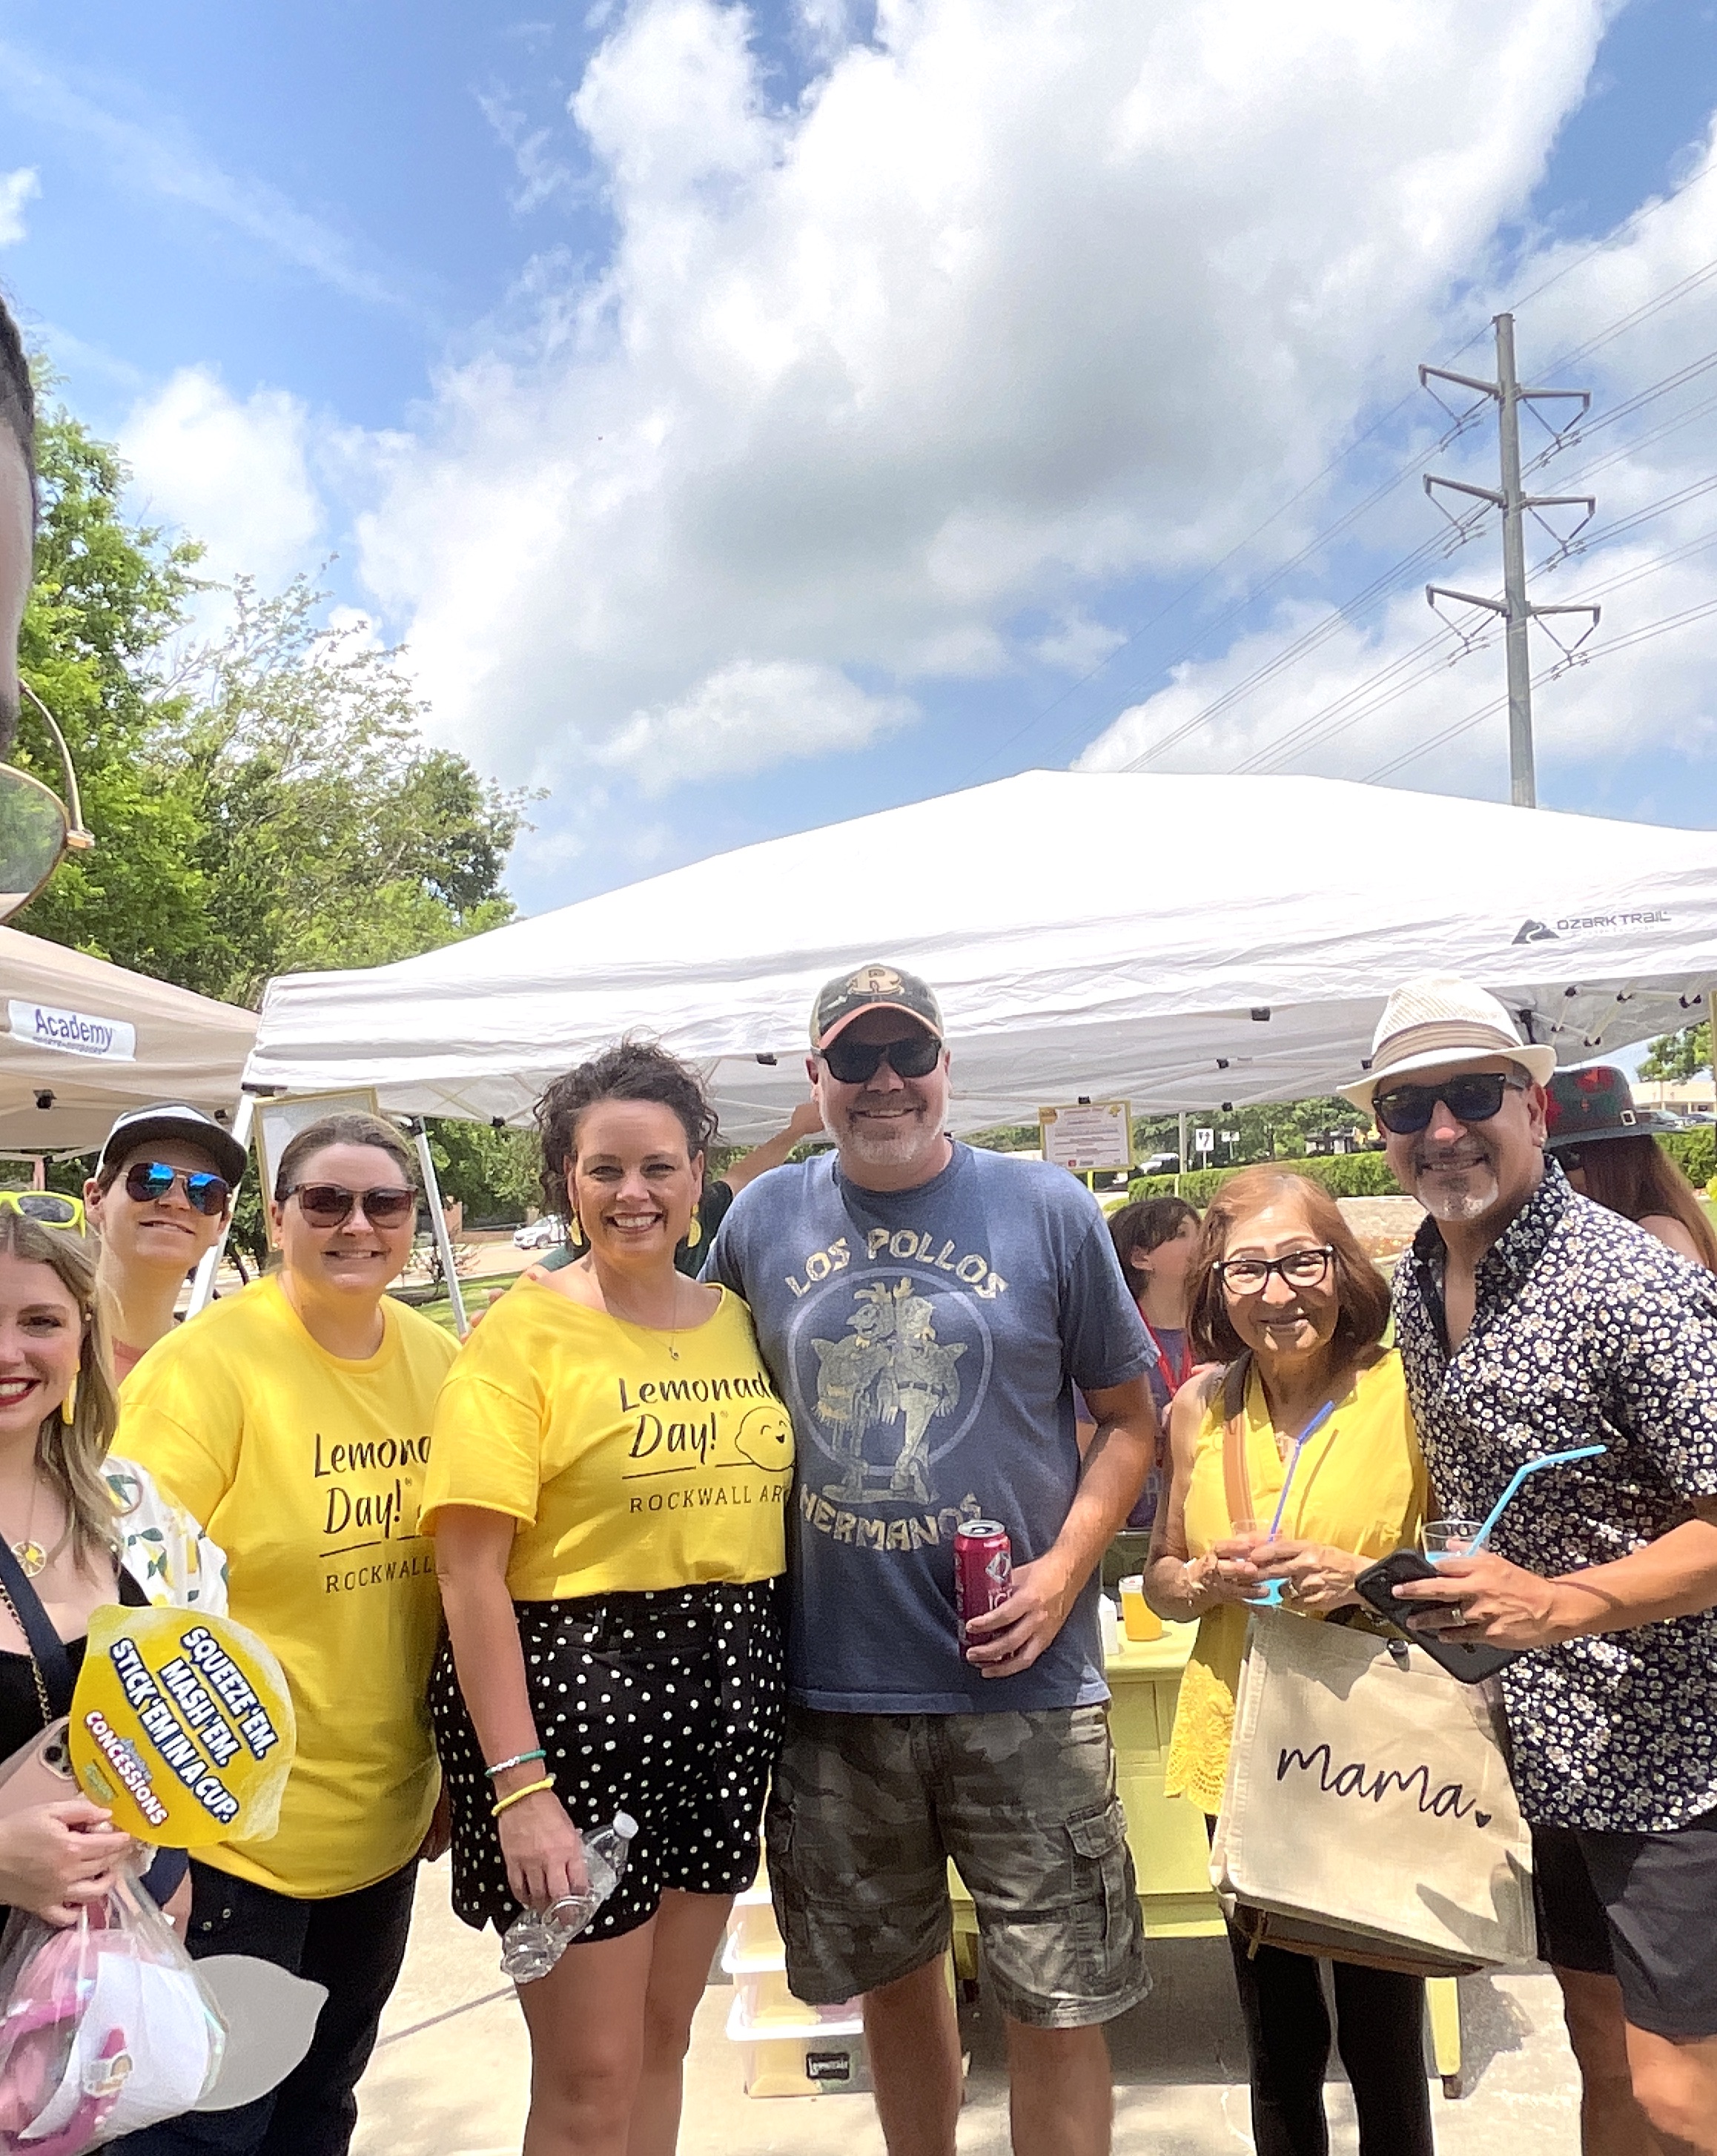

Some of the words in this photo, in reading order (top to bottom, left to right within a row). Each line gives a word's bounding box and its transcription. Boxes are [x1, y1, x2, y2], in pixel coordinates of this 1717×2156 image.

[1557, 916, 1616, 930] OZARK
[35, 1008, 113, 1053] Academy
[784, 1237, 850, 1297] LOS
[867, 1228, 1010, 1298] POLLOS
[619, 1372, 773, 1412] Lemonad
[314, 1433, 431, 1478] Lemona
[629, 1412, 716, 1465] Day!
[322, 1478, 401, 1539] Day!
[629, 1485, 752, 1513] ROCKWALL
[759, 1484, 784, 1503] AR
[799, 1484, 982, 1551] HERMANOS
[325, 1555, 434, 1594] ROCKWALL
[110, 1639, 159, 1710] STICK
[182, 1626, 258, 1718] SQUEEZE
[239, 1706, 278, 1760] 'EM.
[137, 1697, 182, 1743] 'EM
[159, 1657, 217, 1729] MASH
[199, 1715, 242, 1768] 'EM.
[85, 1711, 168, 1826] CONCESSIONS
[159, 1733, 198, 1770] IN
[177, 1759, 208, 1788] A
[193, 1776, 239, 1823] CUP.
